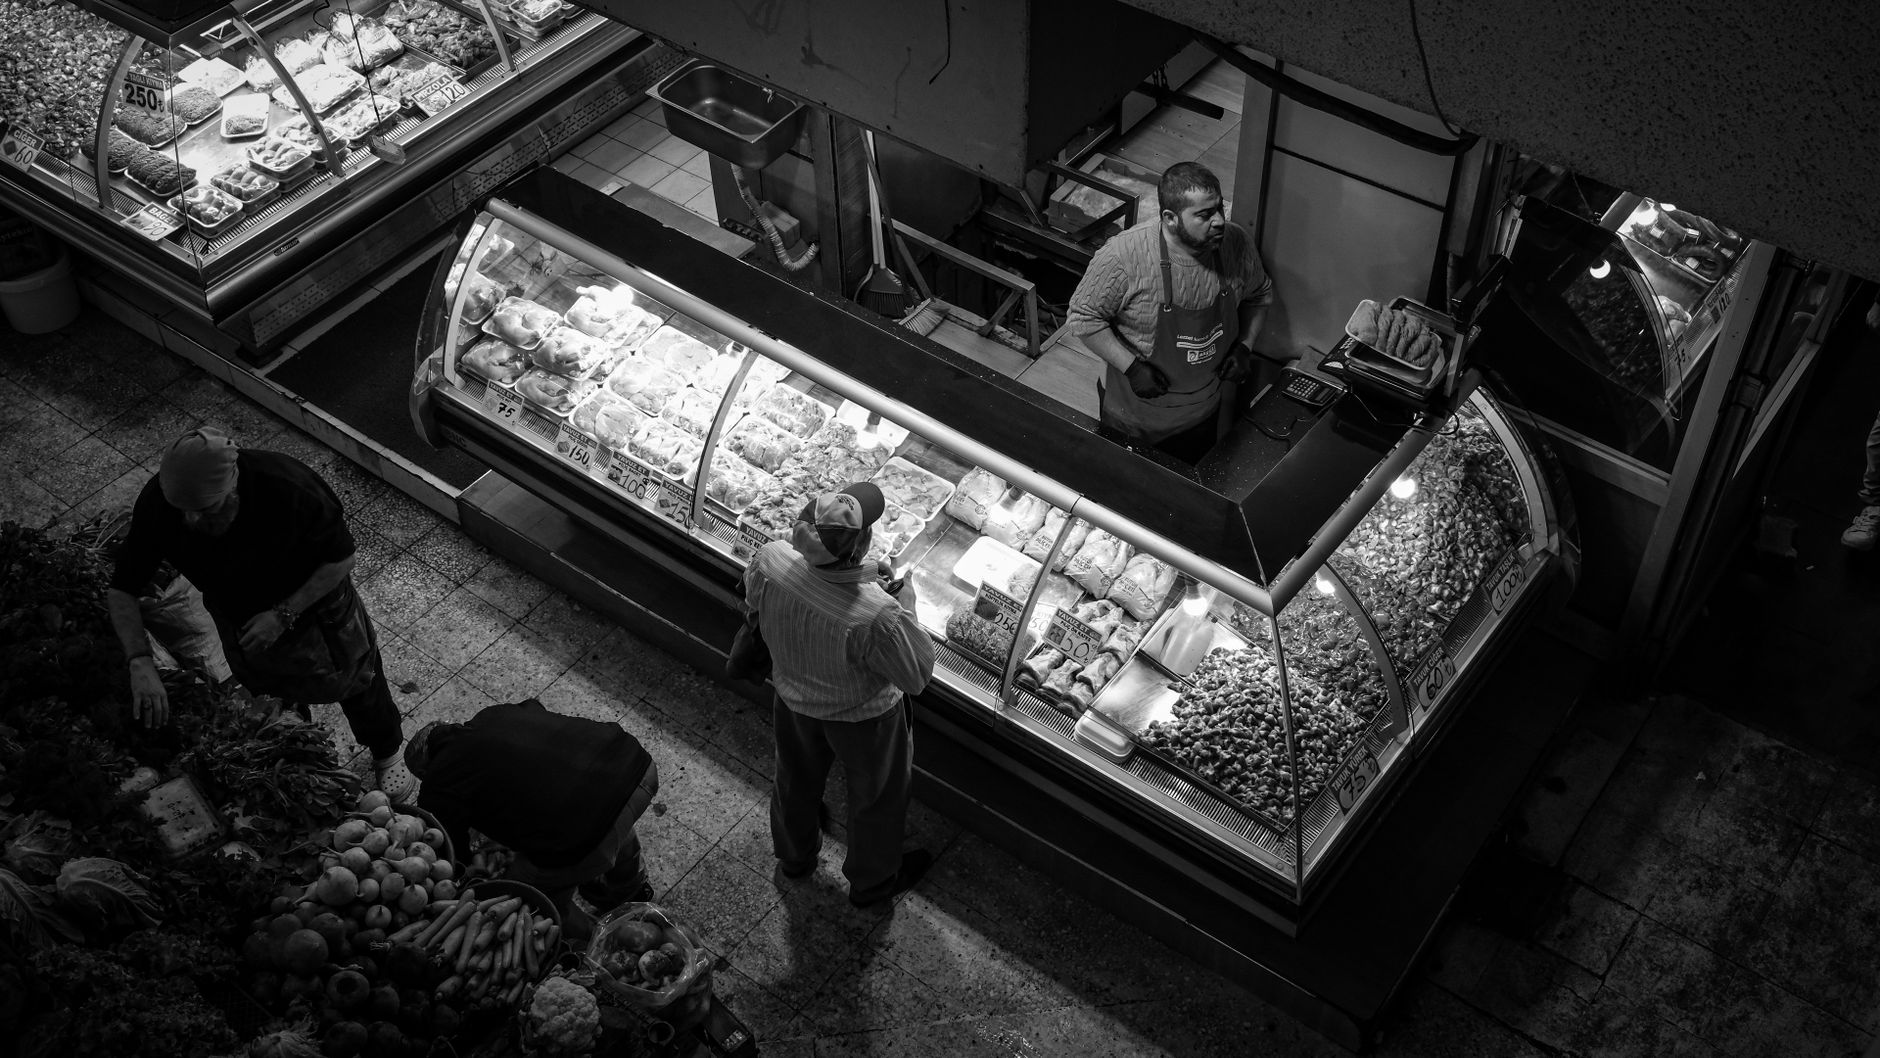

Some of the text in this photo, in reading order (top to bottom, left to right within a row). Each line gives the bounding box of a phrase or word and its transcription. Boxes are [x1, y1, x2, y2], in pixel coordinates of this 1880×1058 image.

[15, 146, 33, 164] 60
[149, 207, 179, 225] BAGET
[498, 402, 516, 418] 75
[563, 424, 581, 439] YAVUZ
[665, 482, 688, 499] YAVUZ
[746, 526, 768, 544] YAVUZ
[1486, 570, 1502, 592] TAVUK
[984, 585, 1011, 604] YAVUZ
[1057, 610, 1080, 627] YAVUZ
[1079, 624, 1090, 634] ET
[1413, 663, 1431, 687] TAVUK
[1331, 767, 1351, 791] TAVUK
